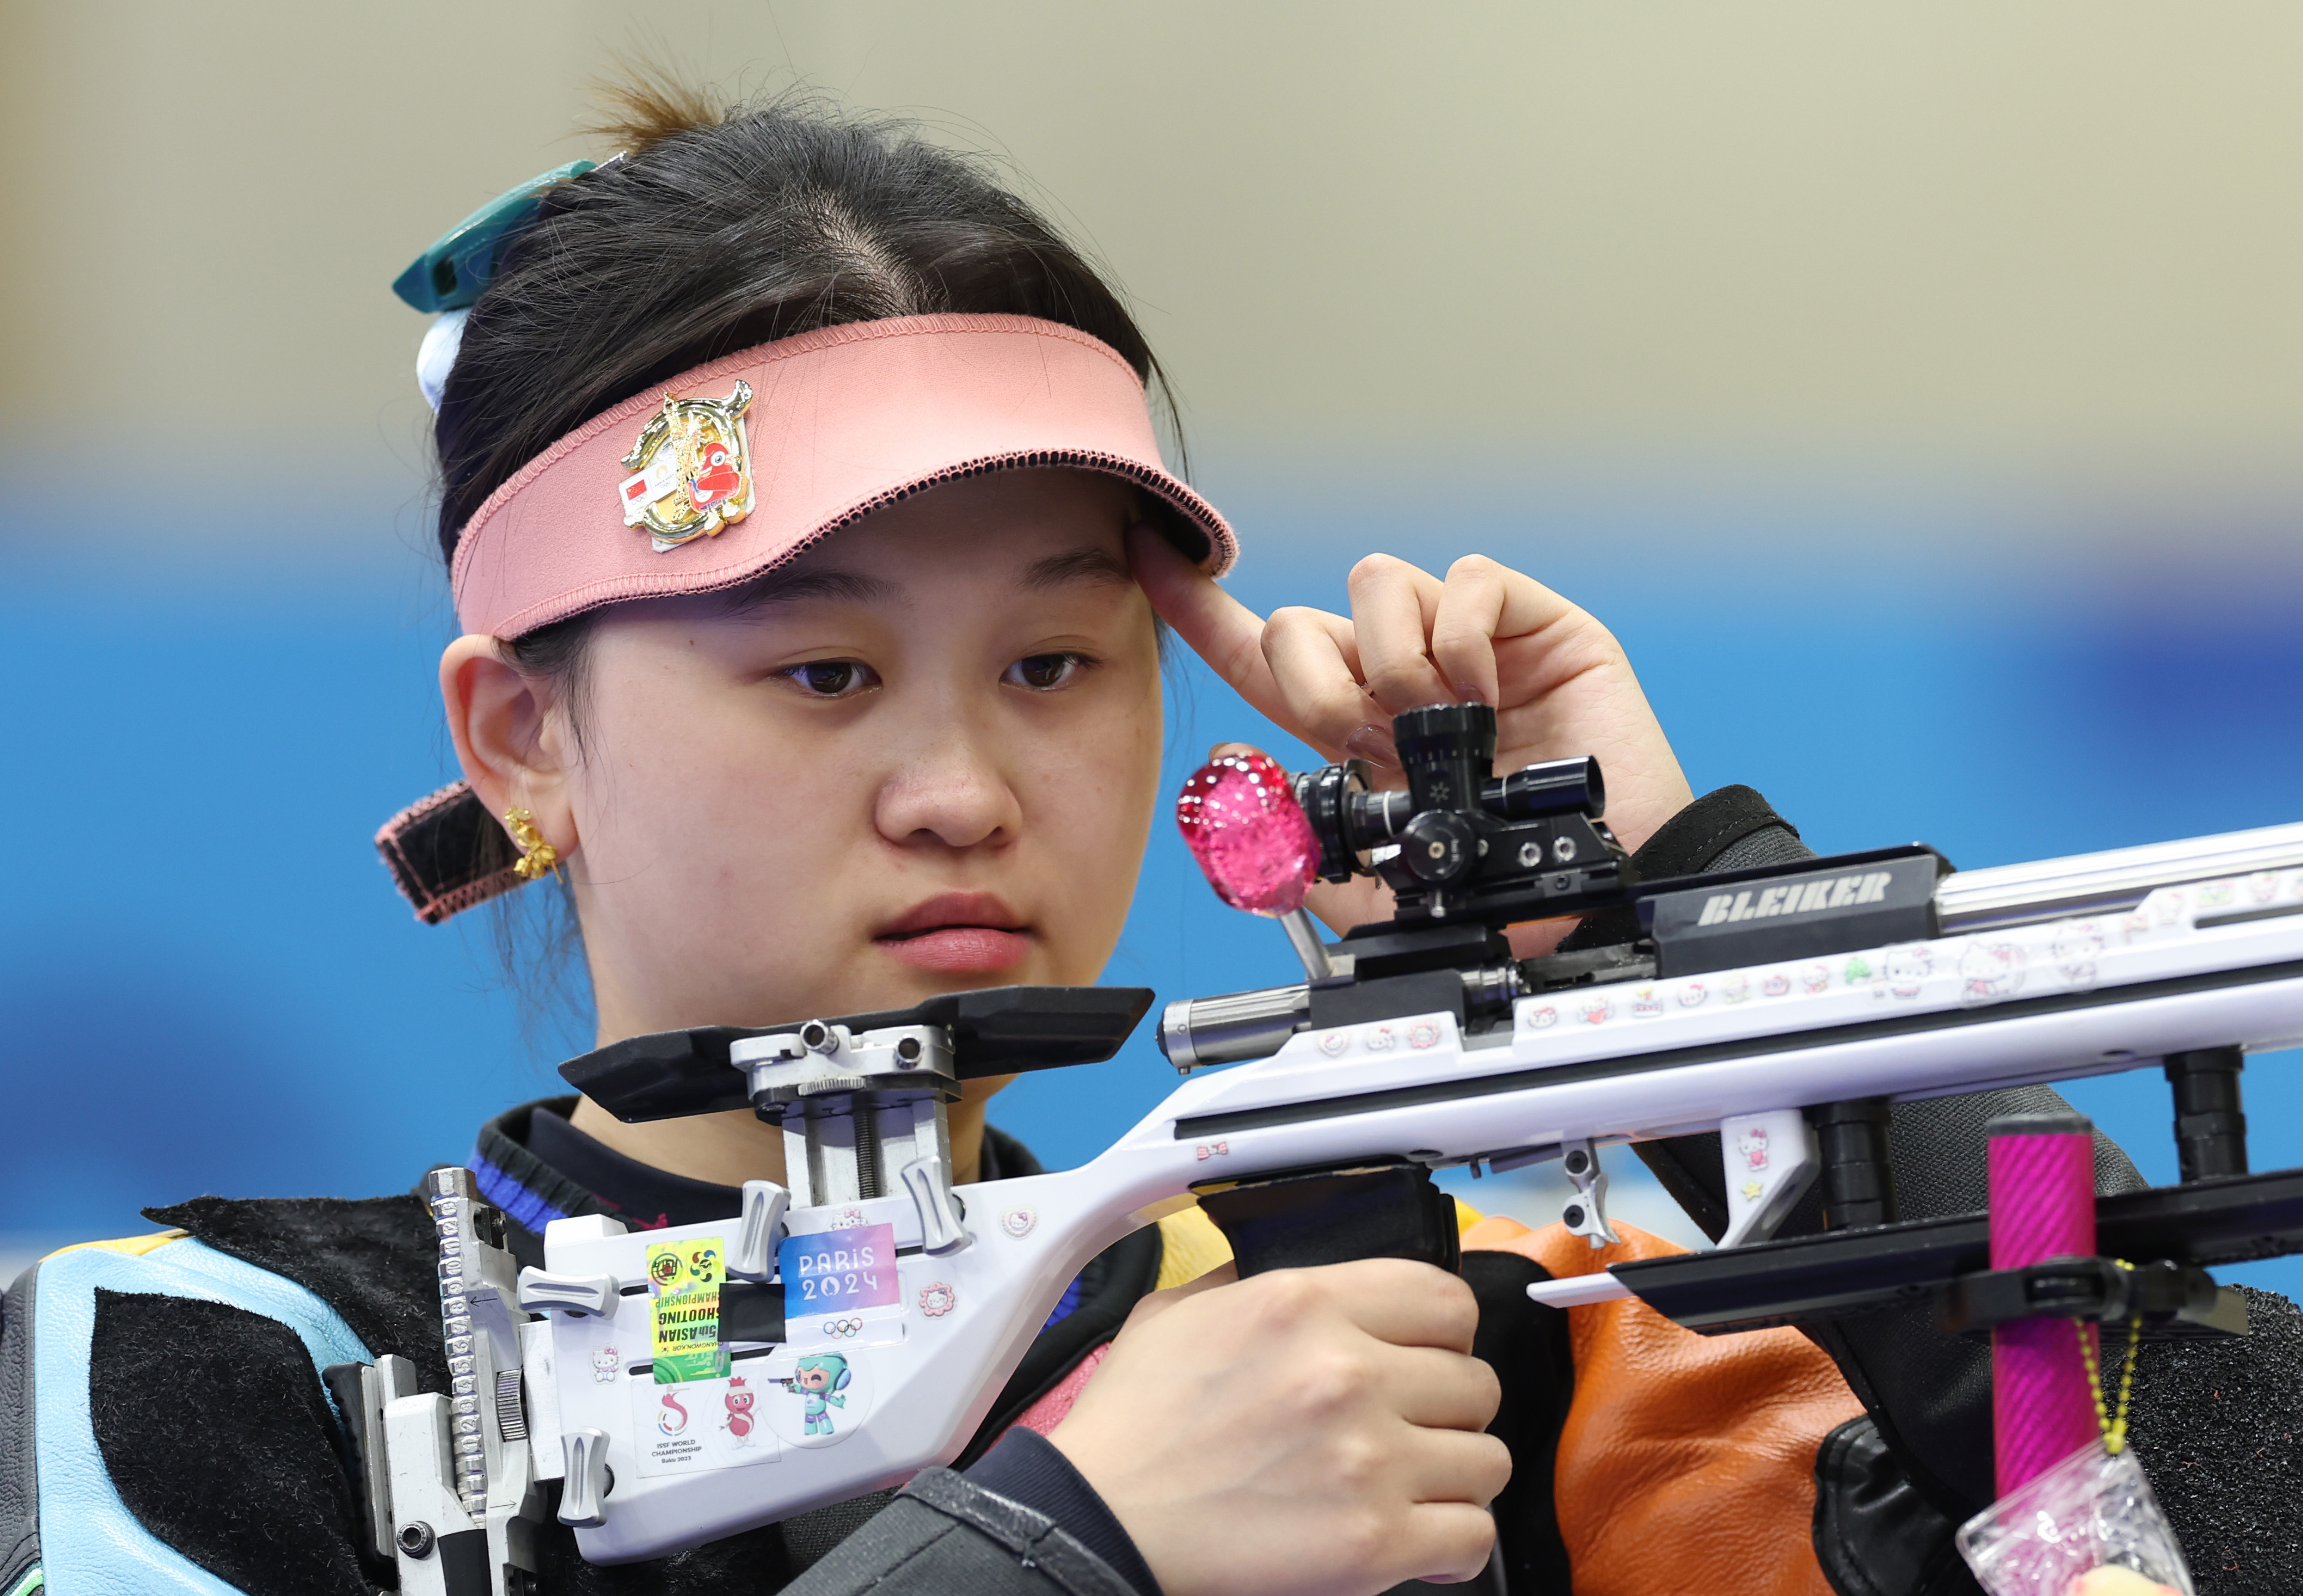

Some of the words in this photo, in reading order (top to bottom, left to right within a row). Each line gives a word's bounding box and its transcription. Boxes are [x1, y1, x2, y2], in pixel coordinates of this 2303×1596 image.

[1697, 871, 1892, 926] BLEIKER
[443, 1221, 458, 1235] 12
[444, 1242, 459, 1255] 11
[446, 1261, 461, 1275] 10
[448, 1281, 463, 1293] 9
[802, 1272, 877, 1300] 2024
[655, 1291, 720, 1308] HAMPIONSHIP
[450, 1301, 465, 1312] 8
[452, 1321, 467, 1333] 7
[659, 1327, 698, 1343] ASIAN
[454, 1341, 468, 1352] 6
[455, 1361, 469, 1372] 5
[457, 1380, 472, 1391] 4
[461, 1420, 476, 1432] 2
[462, 1440, 477, 1450] 1
[652, 1446, 702, 1457] CHAMPIONSHIP
